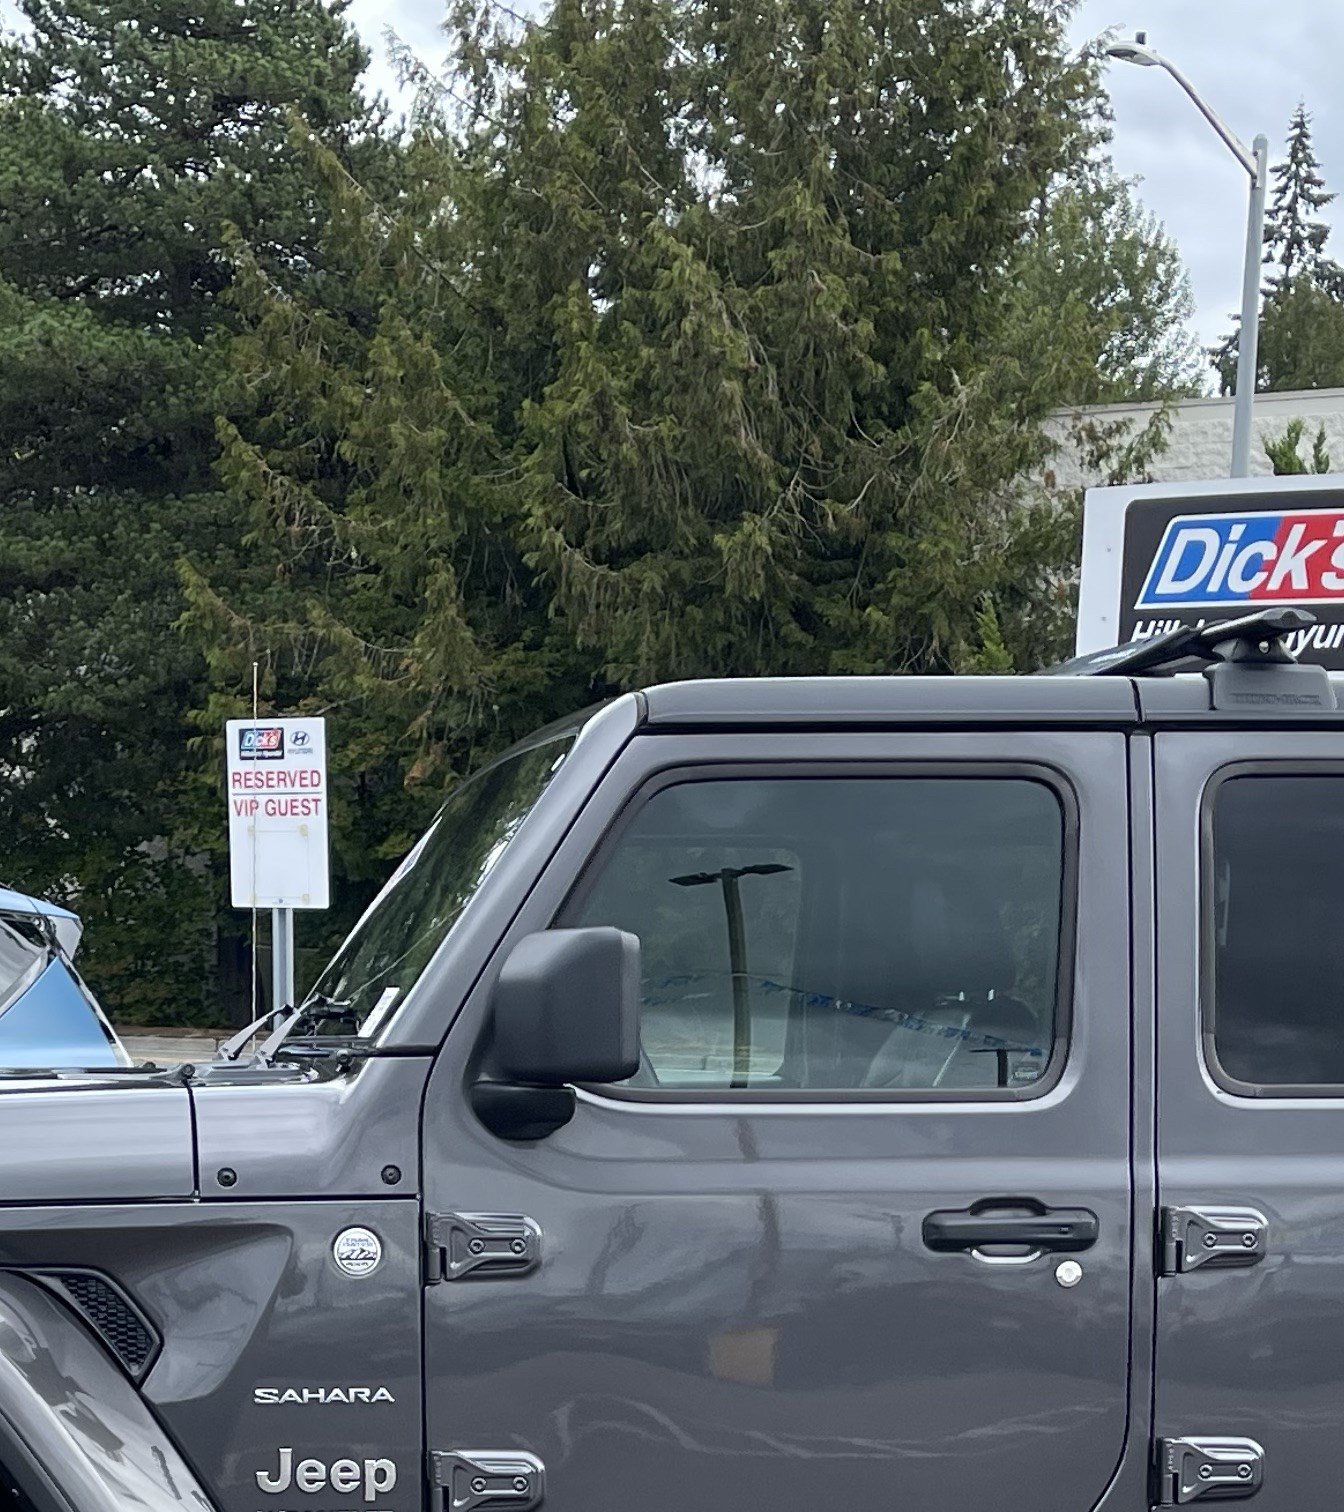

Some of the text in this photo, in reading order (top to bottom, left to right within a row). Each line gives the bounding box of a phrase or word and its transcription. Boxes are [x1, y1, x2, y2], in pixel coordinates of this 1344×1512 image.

[232, 769, 321, 789] RESERVED
[233, 798, 322, 817] VIP GUEST
[254, 1387, 396, 1404] SAHARA
[255, 1447, 397, 1501] Jeep
